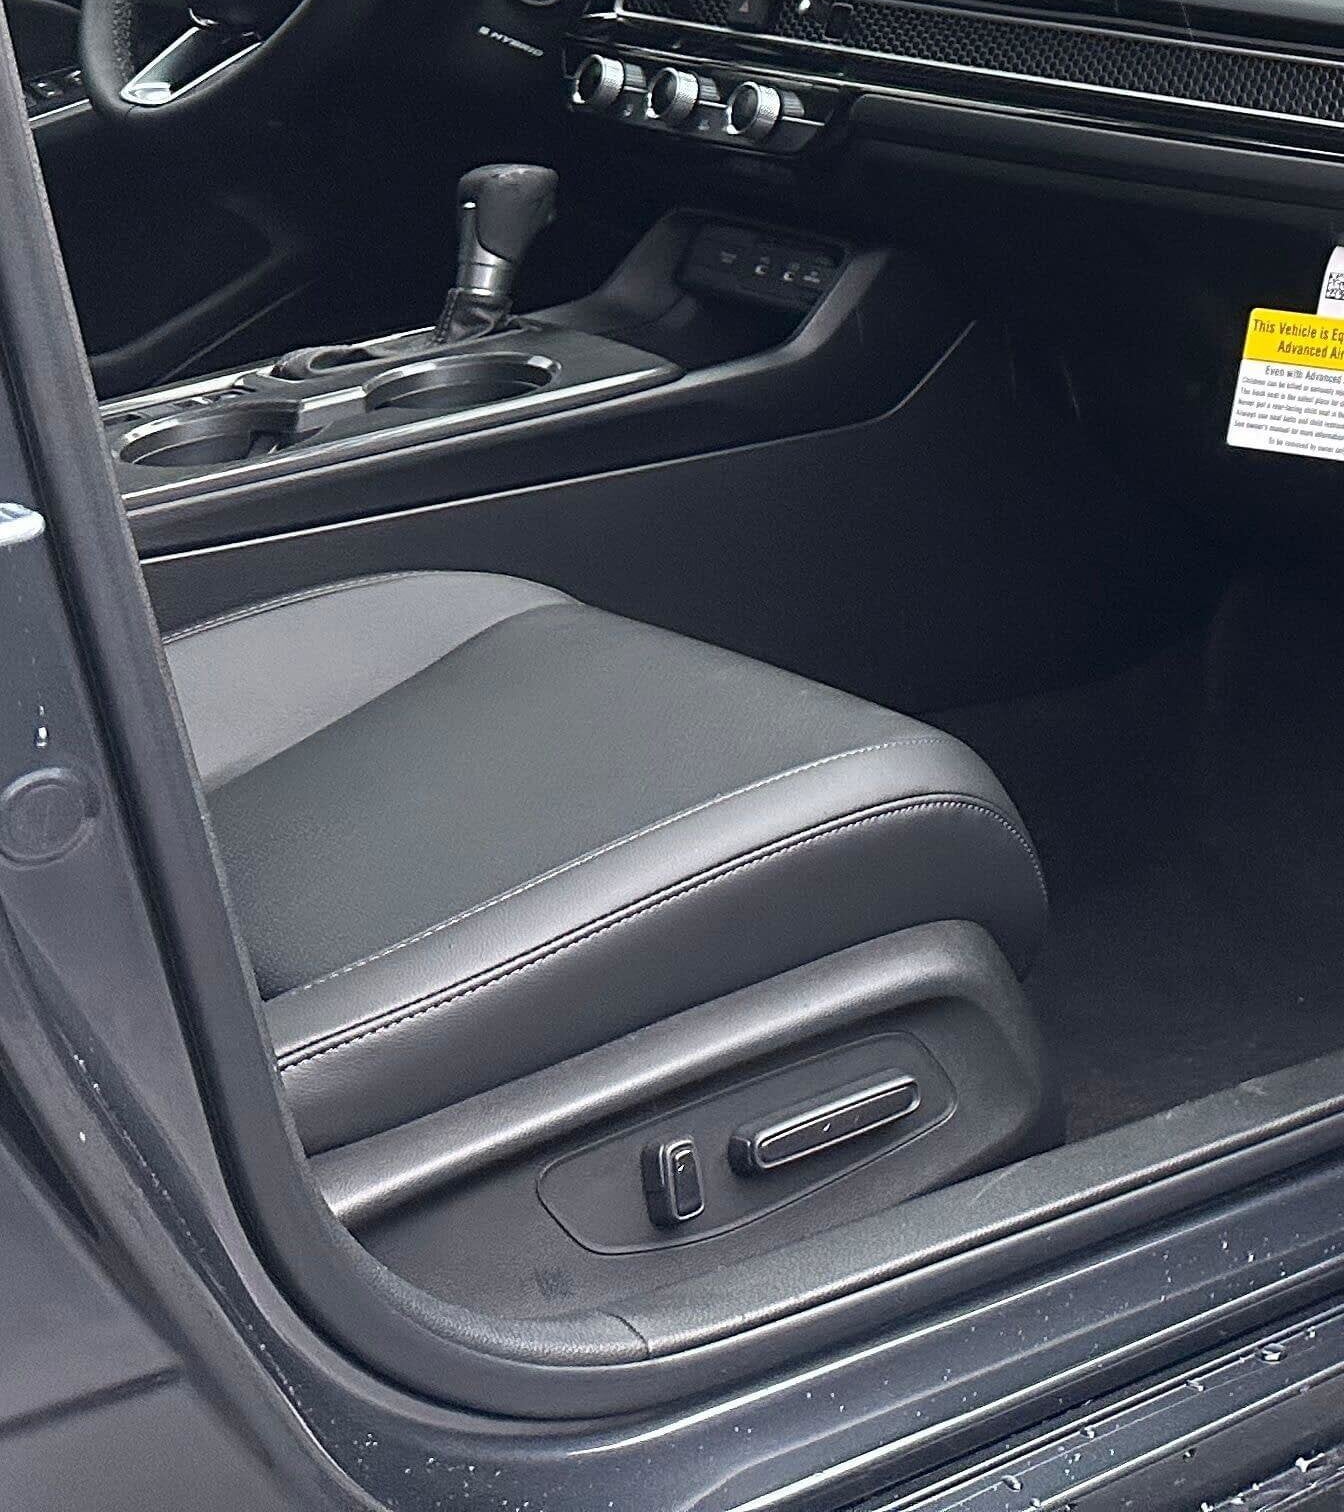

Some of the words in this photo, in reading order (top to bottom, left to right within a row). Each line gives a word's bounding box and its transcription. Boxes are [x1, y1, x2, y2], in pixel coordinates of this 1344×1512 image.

[1254, 319, 1275, 333] This
[1280, 323, 1317, 338] Vehicle
[1320, 327, 1329, 340] is
[1278, 341, 1328, 358] Advanced
[1330, 347, 1344, 360] Air
